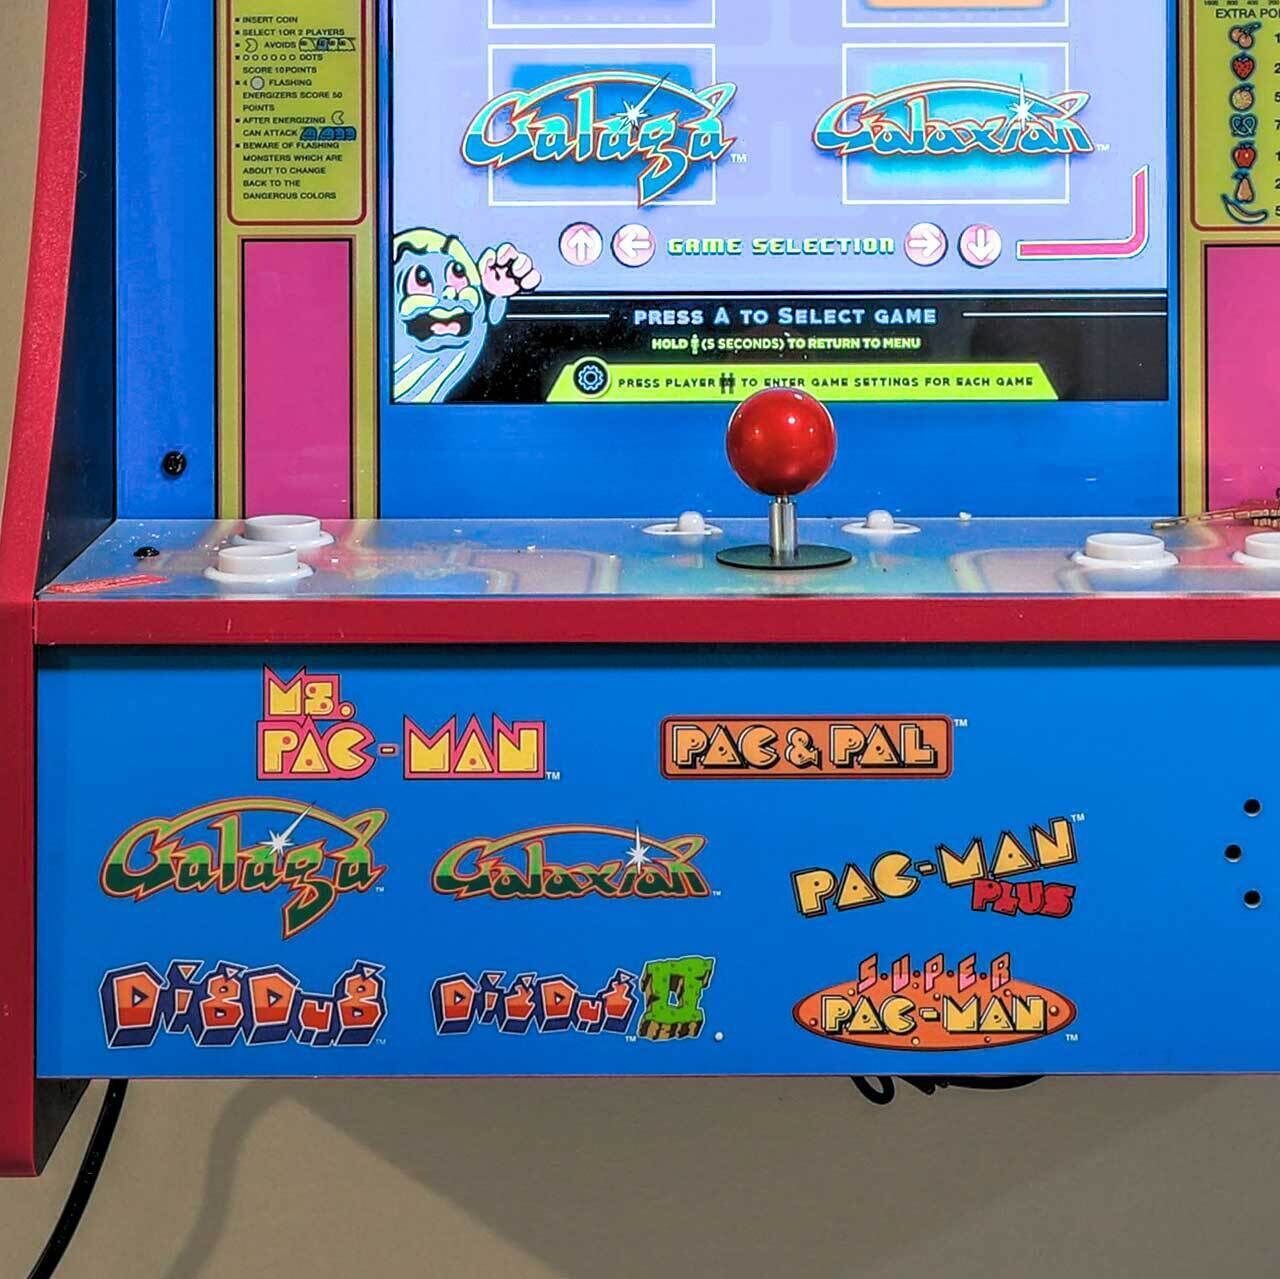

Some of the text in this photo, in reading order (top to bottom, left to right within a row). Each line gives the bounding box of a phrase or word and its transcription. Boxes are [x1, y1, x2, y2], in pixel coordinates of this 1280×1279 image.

[1215, 8, 1256, 18] EXTRA
[812, 78, 1095, 156] Galaxian
[460, 70, 737, 208] Galaga
[243, 192, 337, 200] DANGEROUS COLORS
[667, 237, 895, 256] GAME SELECTION
[634, 309, 704, 325] PRESS
[714, 307, 730, 325] A
[740, 309, 769, 325] TO
[874, 308, 936, 324] GAME
[651, 338, 688, 350] HOLD
[786, 338, 806, 350] TO
[808, 338, 860, 349] RETURN
[862, 338, 881, 349] TO
[883, 338, 921, 349] MENU
[618, 377, 1033, 388] PRESS PLAYER TO ENTER GAME SETTINGS FOR EACH GAME
[257, 713, 545, 780] PAC-MAN
[672, 724, 780, 768] PAC
[784, 728, 823, 770] &
[829, 723, 938, 768] PAL
[100, 796, 388, 940] Galaga
[431, 823, 712, 901] Galaxian
[790, 816, 1078, 918] PAC-MAN
[972, 878, 1076, 918] PLUS
[821, 993, 1048, 1035] PAC-MAN
